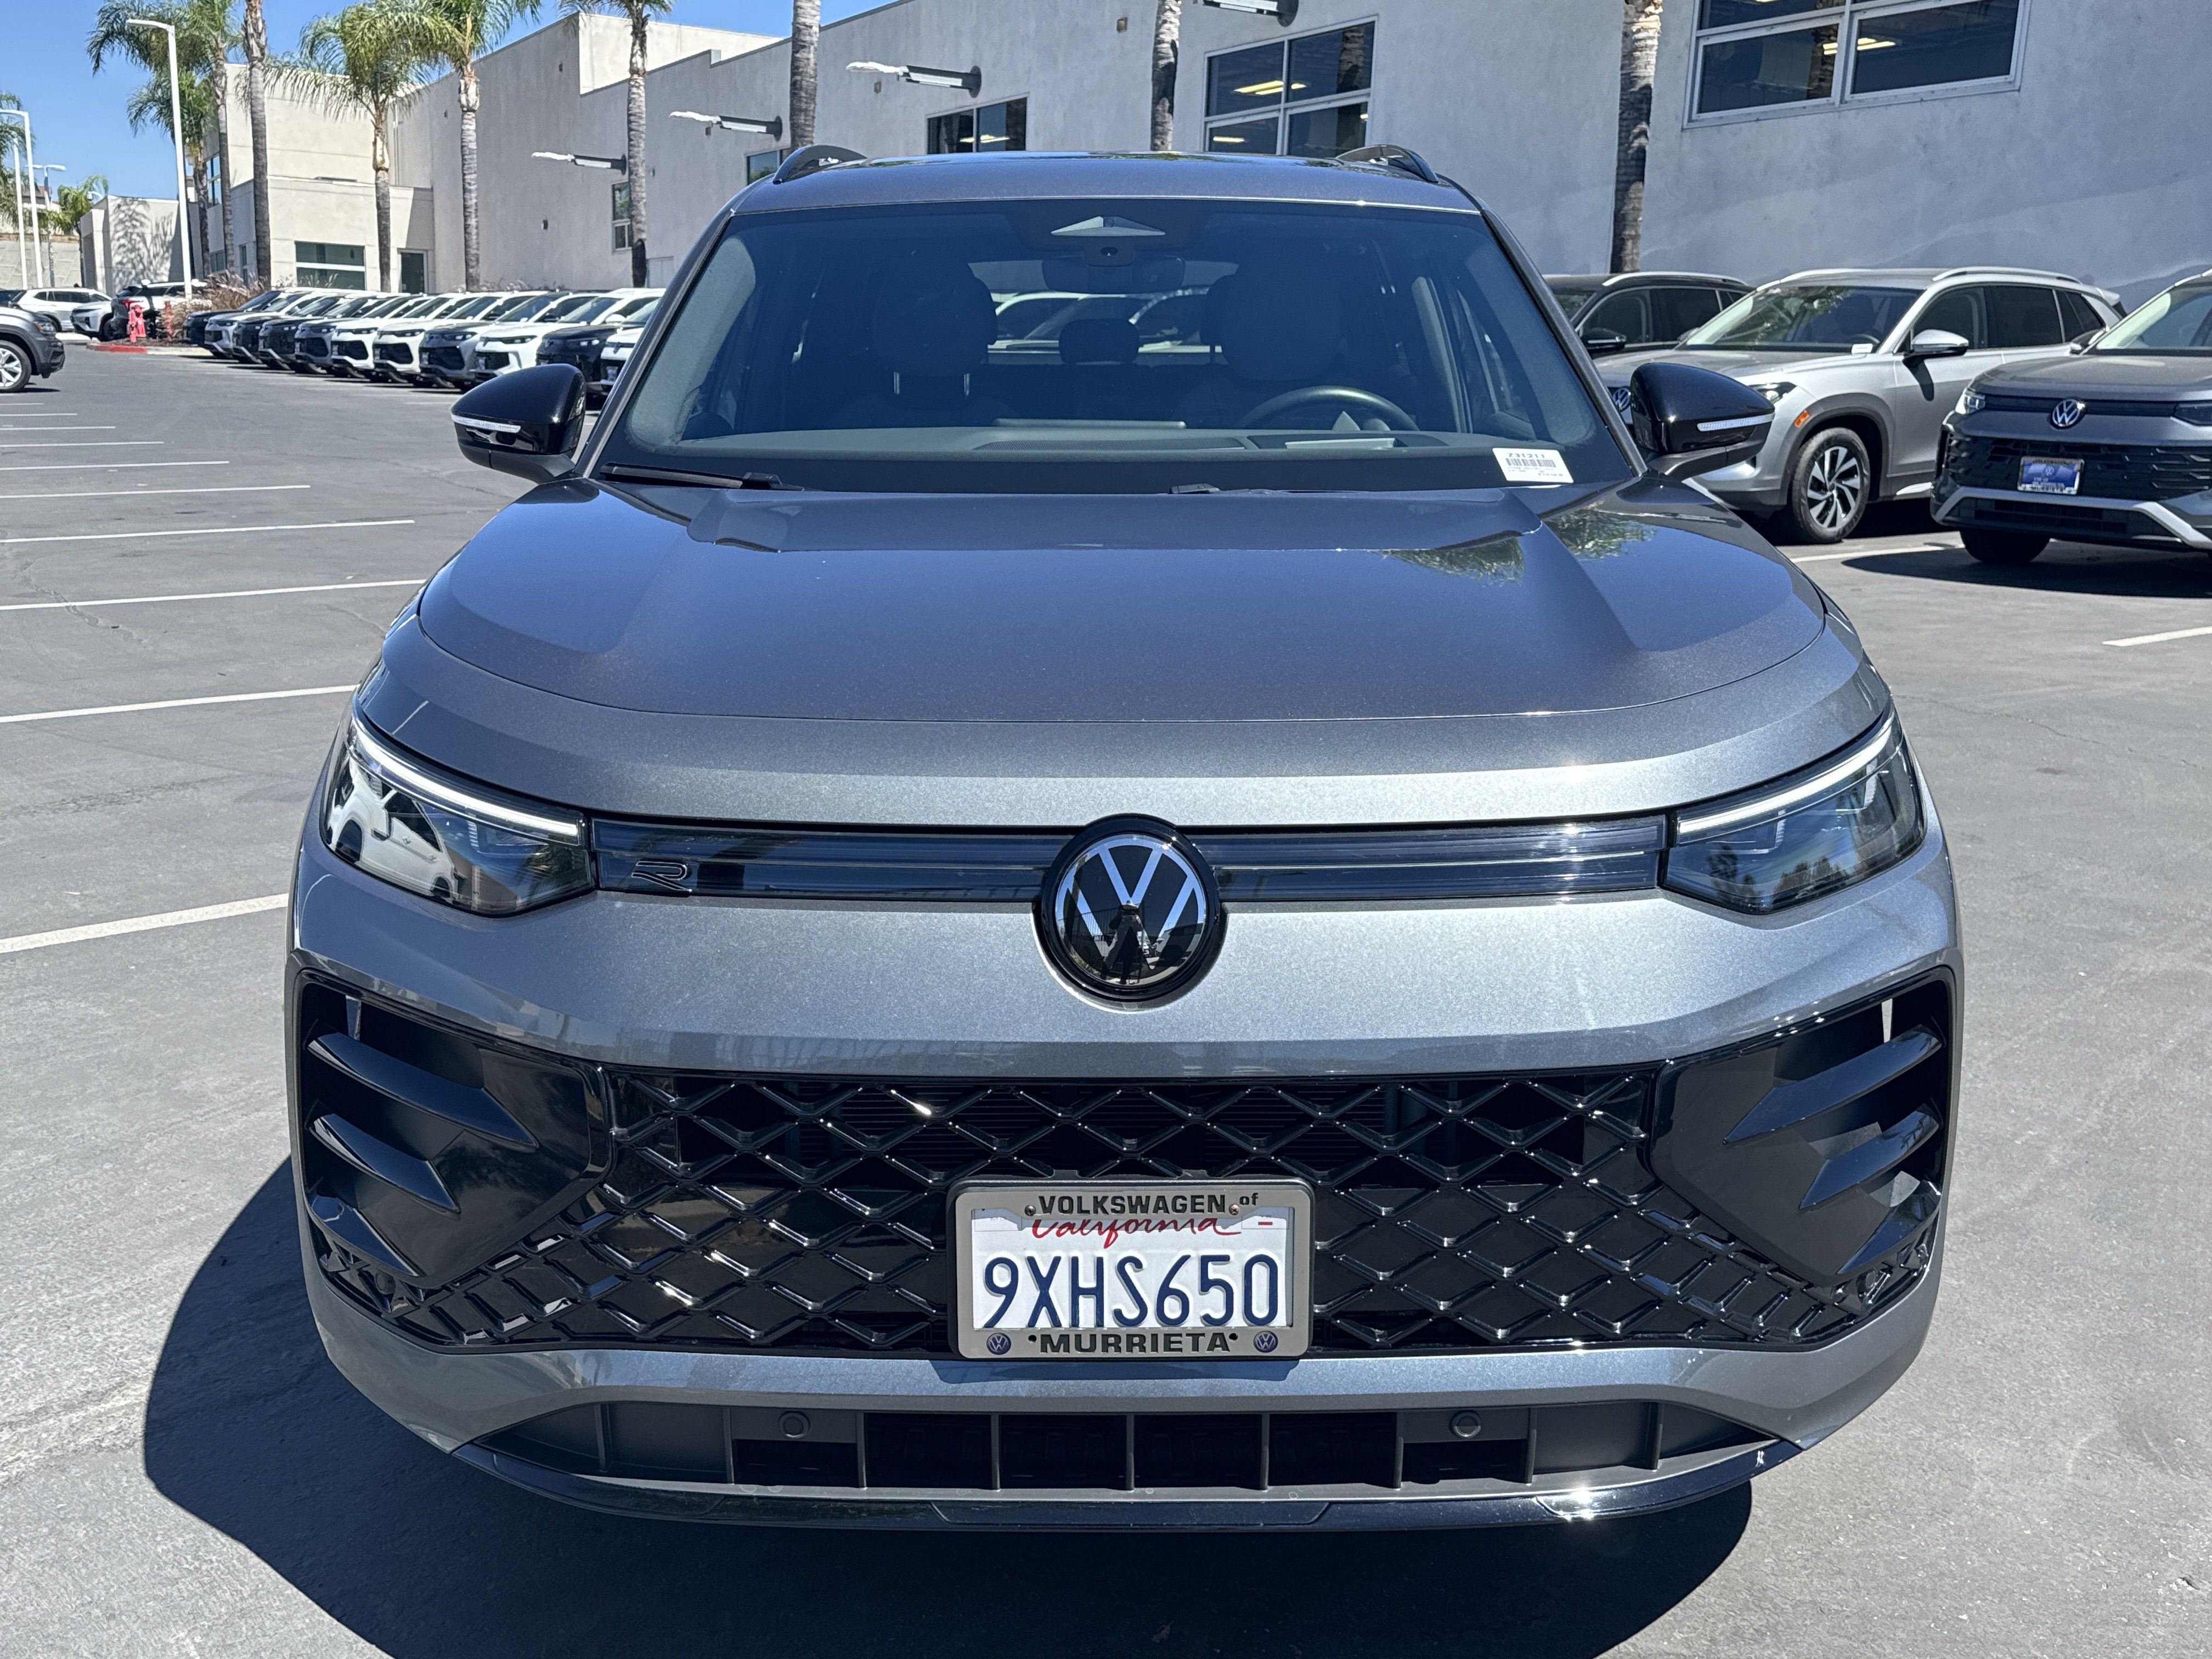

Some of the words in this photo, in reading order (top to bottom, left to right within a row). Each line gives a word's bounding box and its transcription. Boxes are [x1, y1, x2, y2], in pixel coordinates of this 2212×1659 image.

[1039, 1194, 1226, 1215] VOLKSWAGEN
[1240, 1193, 1259, 1206] of
[984, 1254, 1278, 1328] 9XHS650
[1040, 1332, 1229, 1353] MURRIETA
